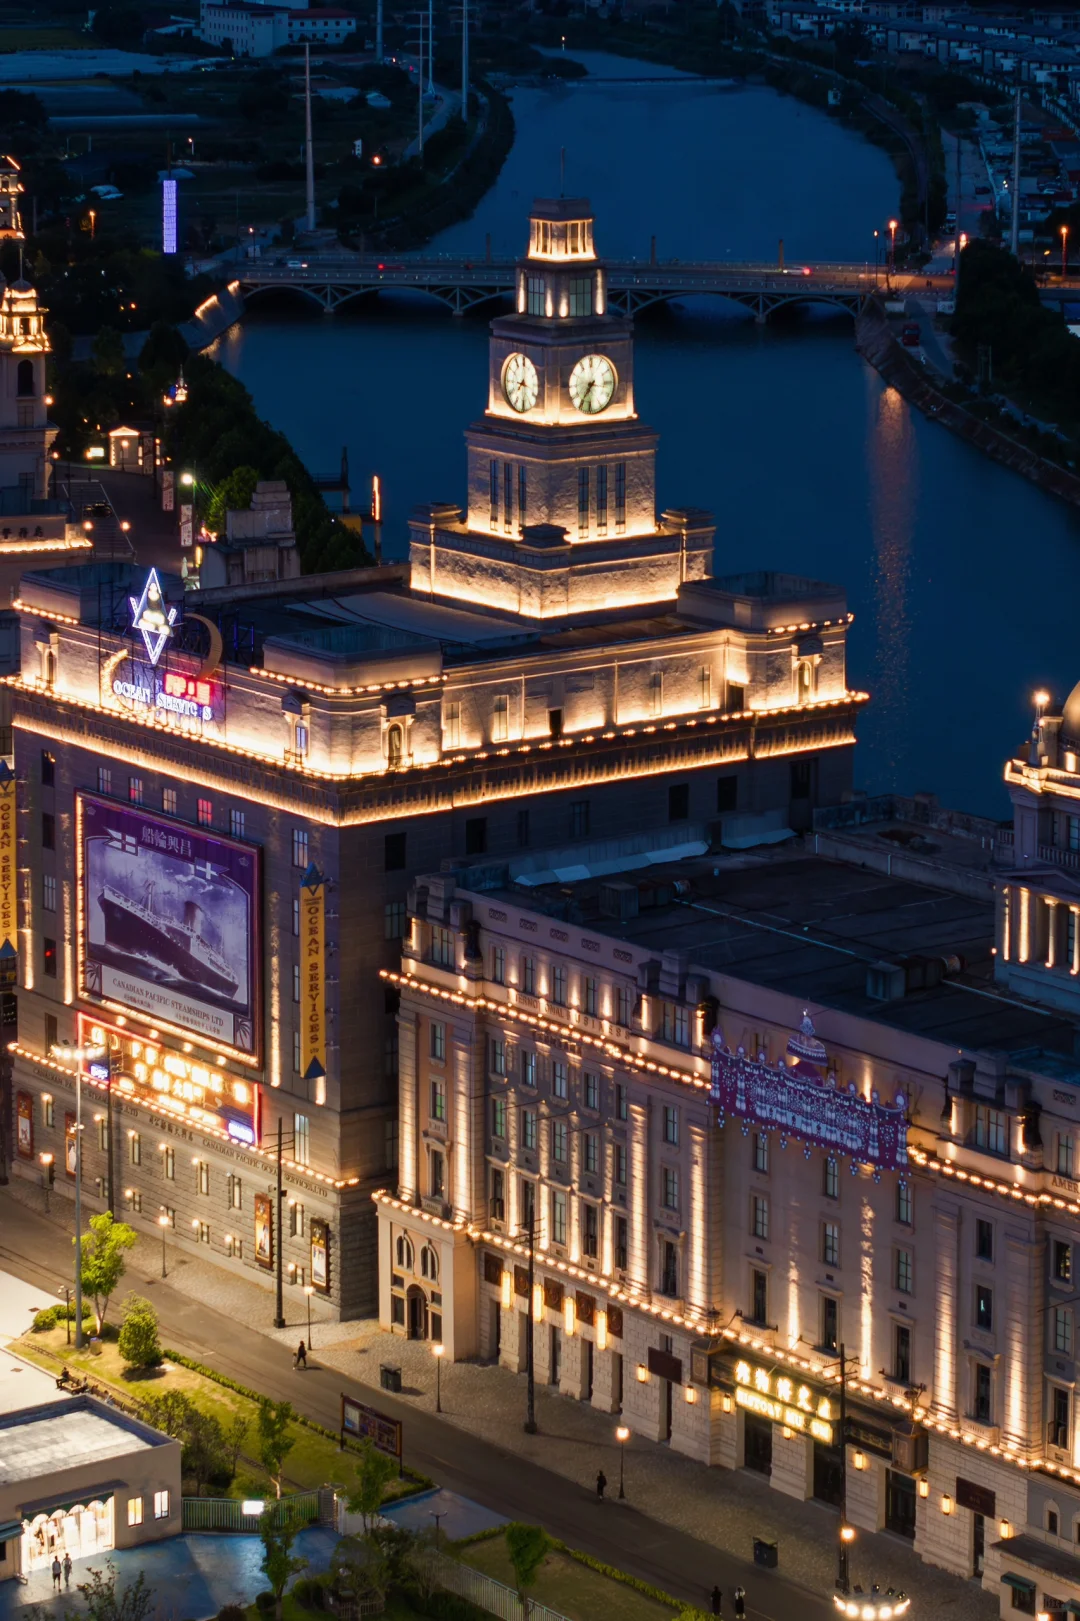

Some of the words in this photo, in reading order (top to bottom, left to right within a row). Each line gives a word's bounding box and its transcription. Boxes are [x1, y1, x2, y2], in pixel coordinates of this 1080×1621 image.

[156, 692, 212, 721] SERVICS
[0, 803, 11, 849] OCEAN
[1, 855, 11, 929] SERVICES
[307, 905, 320, 957] OCEAN
[112, 978, 144, 998] CANADIAN
[144, 988, 169, 1007] PACIFIC
[170, 996, 211, 1022] STEAMSHIPS
[211, 1012, 224, 1028] LTD
[307, 962, 320, 1045] SERVICES
[202, 1138, 235, 1158] CANADIAN
[235, 1152, 260, 1169] PACIFIC
[261, 1163, 279, 1177] OCEA
[1051, 1175, 1079, 1194] AMER
